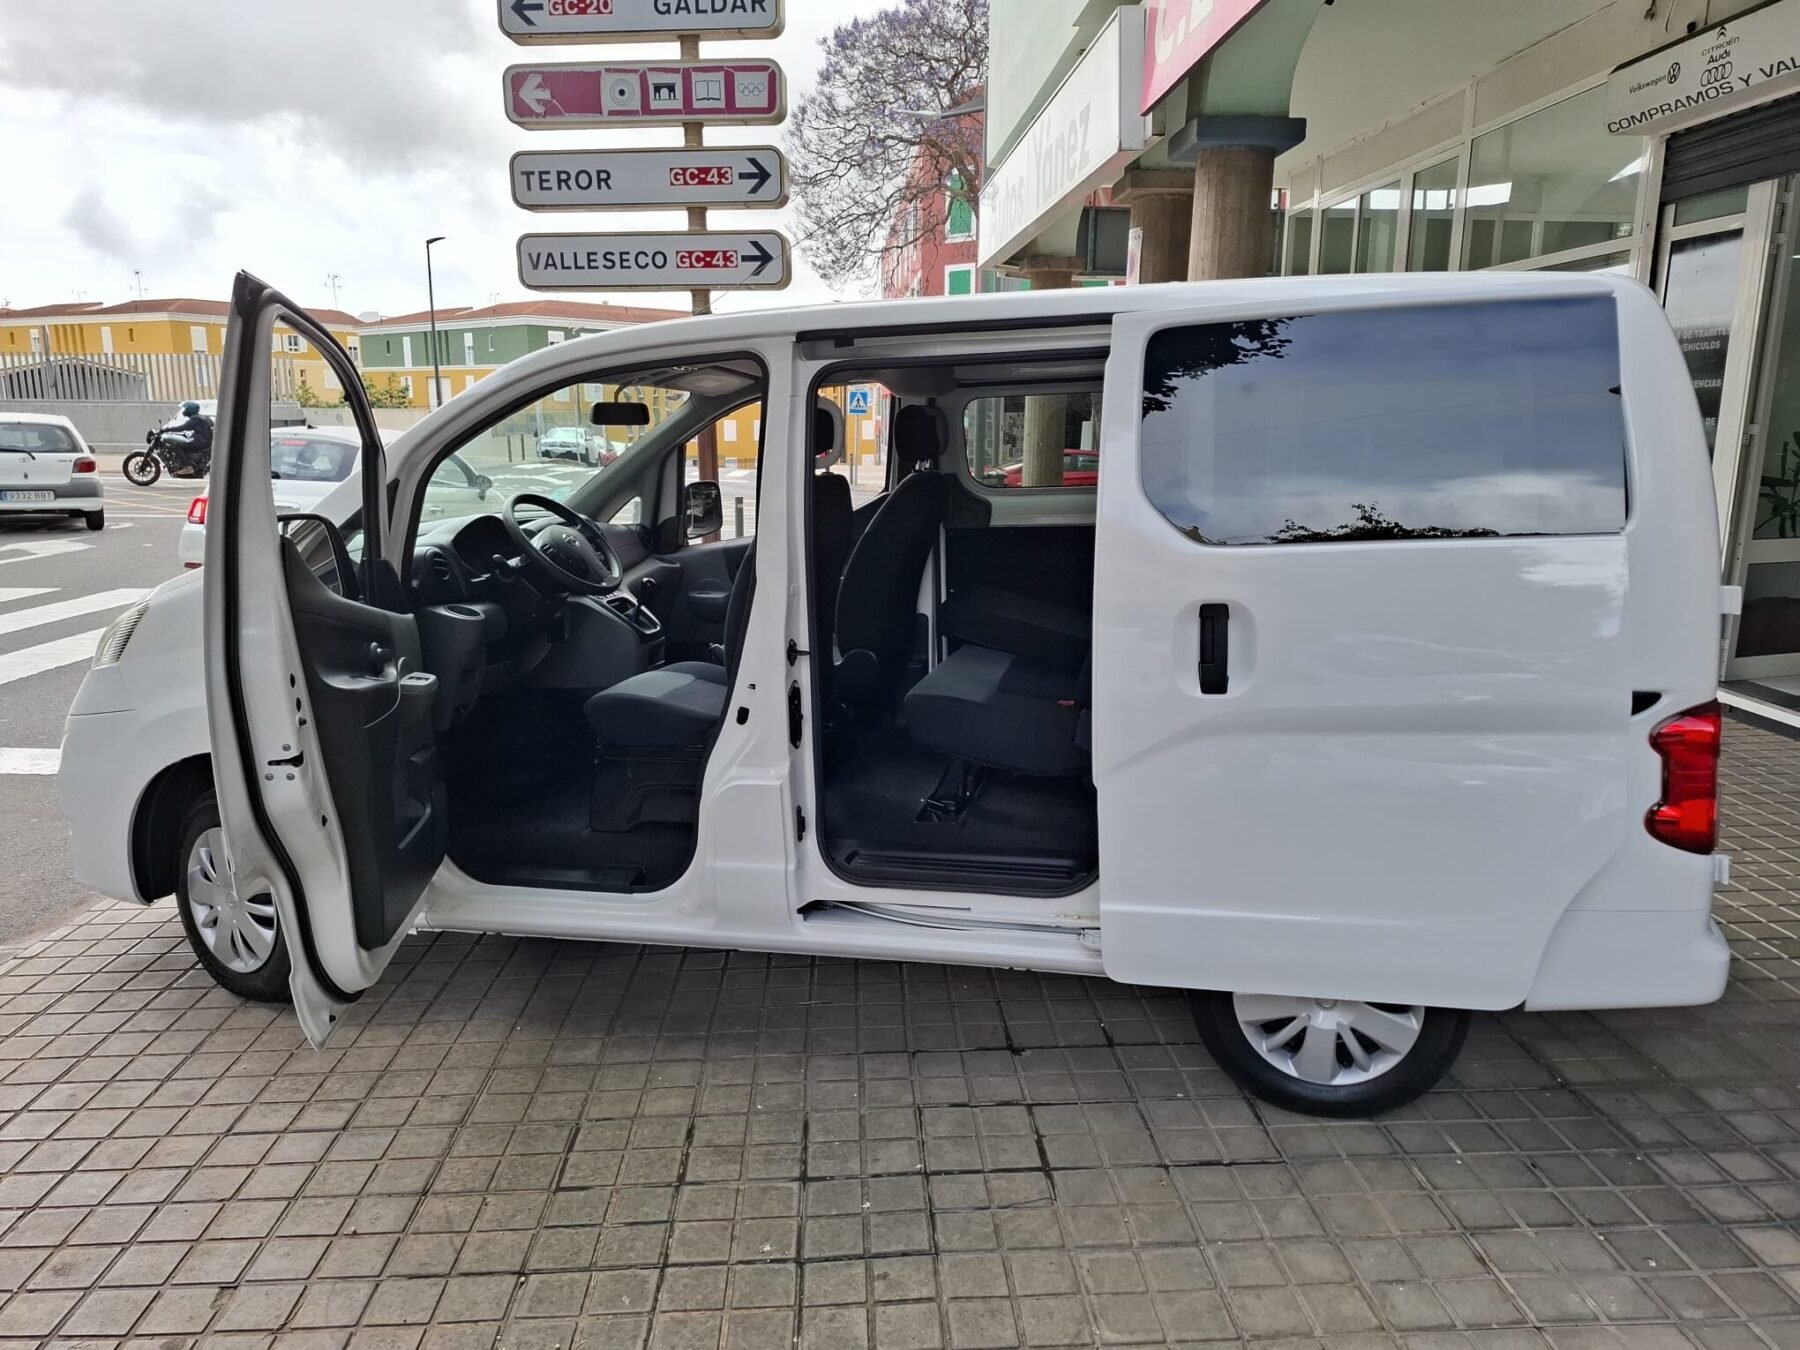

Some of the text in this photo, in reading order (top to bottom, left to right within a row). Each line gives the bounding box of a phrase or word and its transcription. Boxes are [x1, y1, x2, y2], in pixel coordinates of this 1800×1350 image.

[549, 0, 767, 15] GC-20 GALDAR
[1707, 49, 1731, 65] Audi
[1628, 74, 1667, 94] Volkswagen
[1607, 81, 1734, 134] COMPRAMOS
[1738, 73, 1752, 88] Y
[1032, 99, 1092, 211] Yánez
[520, 166, 732, 192] TEROR GC-43
[527, 250, 738, 271] VALLESECO GC-43
